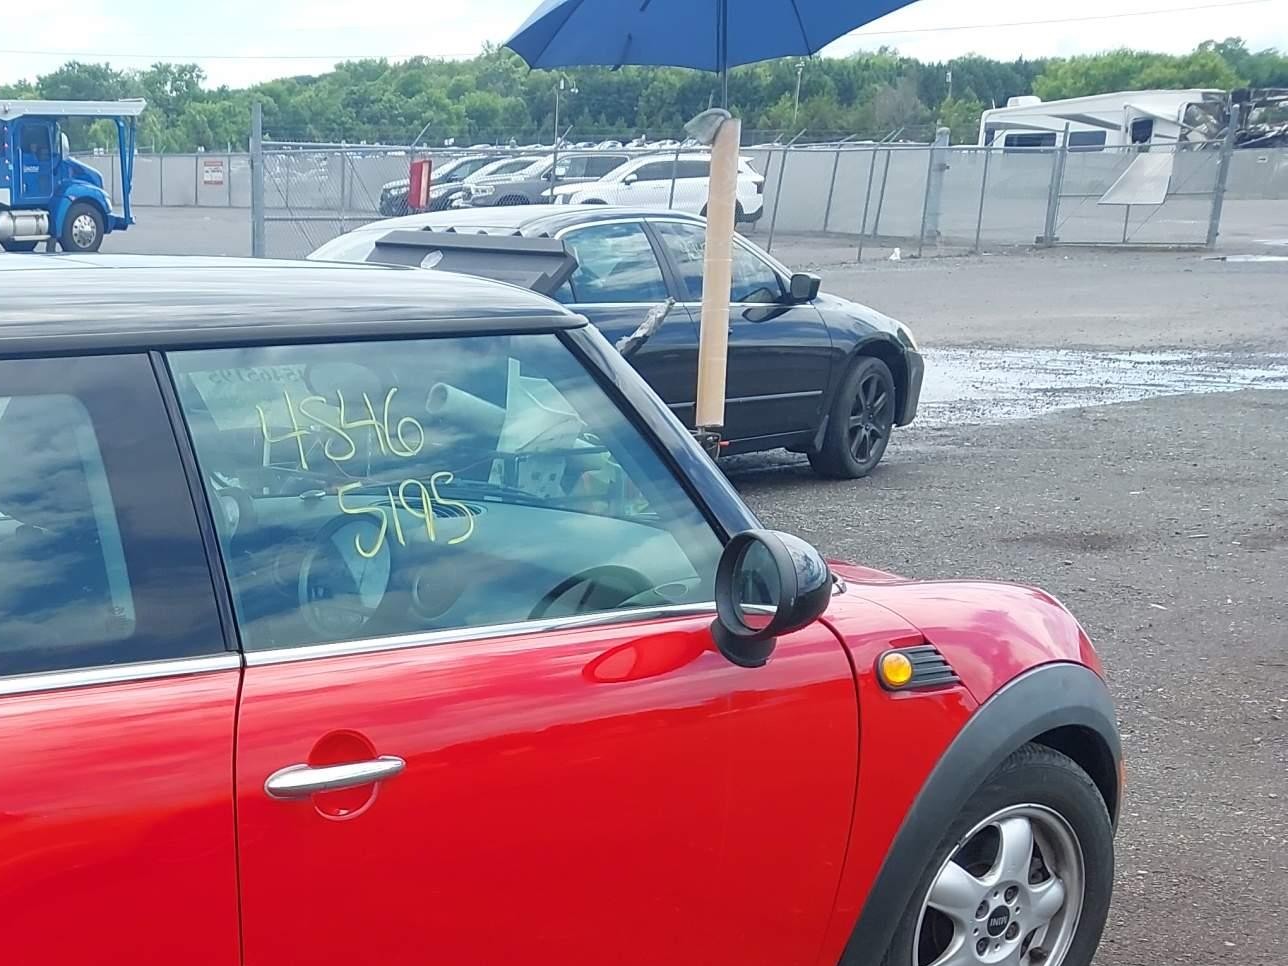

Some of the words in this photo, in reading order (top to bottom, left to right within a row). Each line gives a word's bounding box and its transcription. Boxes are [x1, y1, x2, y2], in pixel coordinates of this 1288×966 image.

[255, 387, 425, 471] 4546
[338, 471, 475, 558] 5195
[990, 915, 1009, 927] MINI
